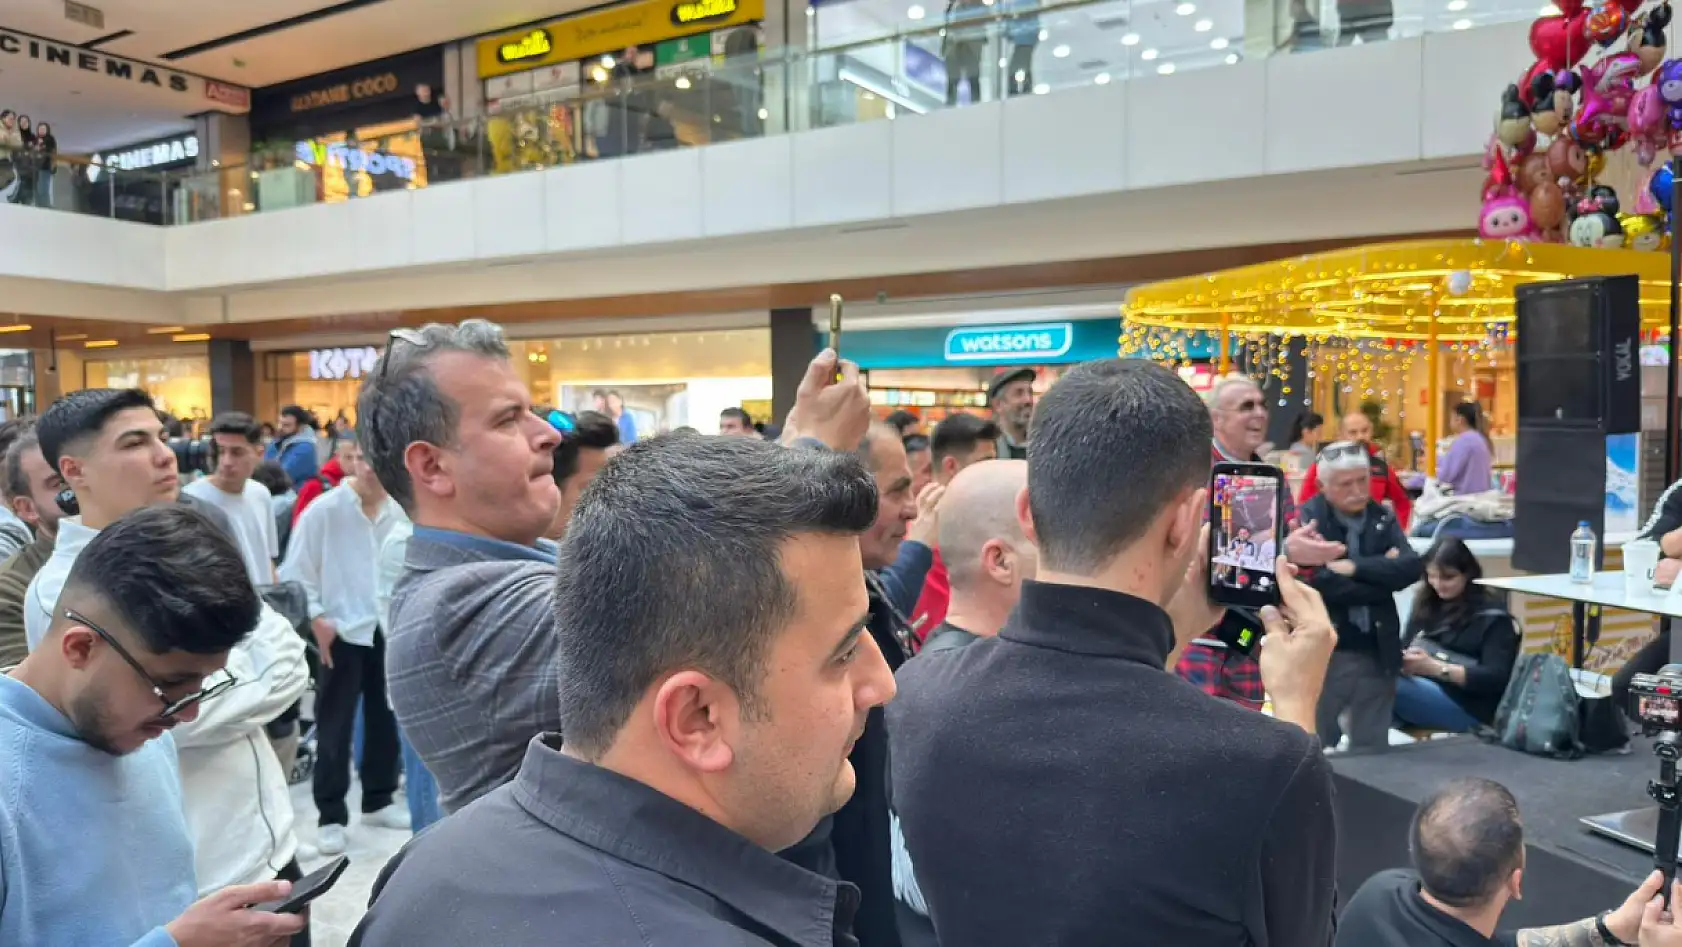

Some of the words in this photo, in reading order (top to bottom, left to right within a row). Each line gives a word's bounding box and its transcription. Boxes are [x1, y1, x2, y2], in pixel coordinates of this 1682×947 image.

[0, 34, 188, 91] CINEMAS
[106, 136, 199, 173] CINEMAS
[961, 332, 1052, 352] watsons
